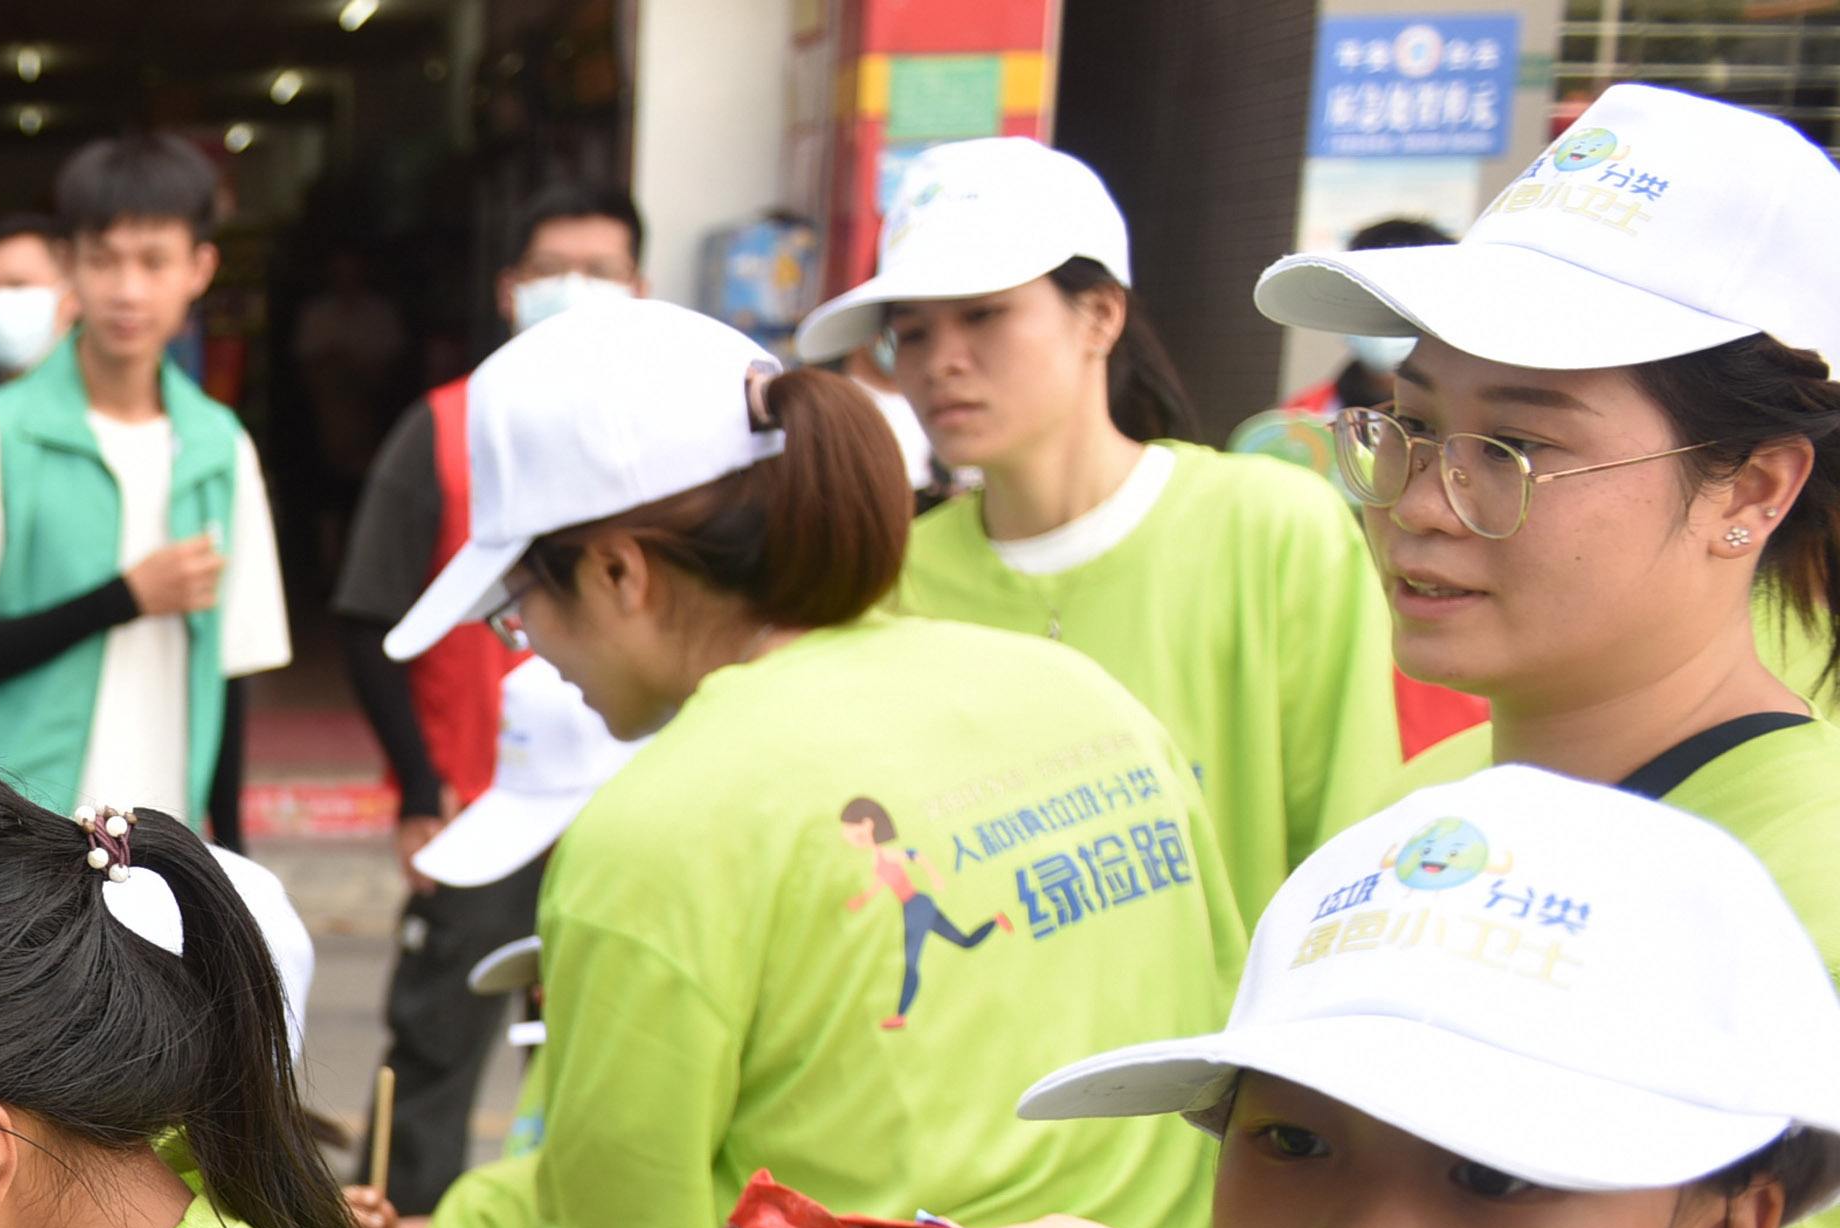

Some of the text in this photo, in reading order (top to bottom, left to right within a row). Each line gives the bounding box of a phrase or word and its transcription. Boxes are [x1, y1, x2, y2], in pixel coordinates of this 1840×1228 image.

[1598, 163, 1670, 201] 分类
[953, 767, 1161, 872] 人和镇垃圾分类
[1015, 820, 1193, 939] 绿捡跑
[1312, 871, 1591, 935] 垃圾 分类
[1290, 907, 1585, 990] 绿色小卫士
